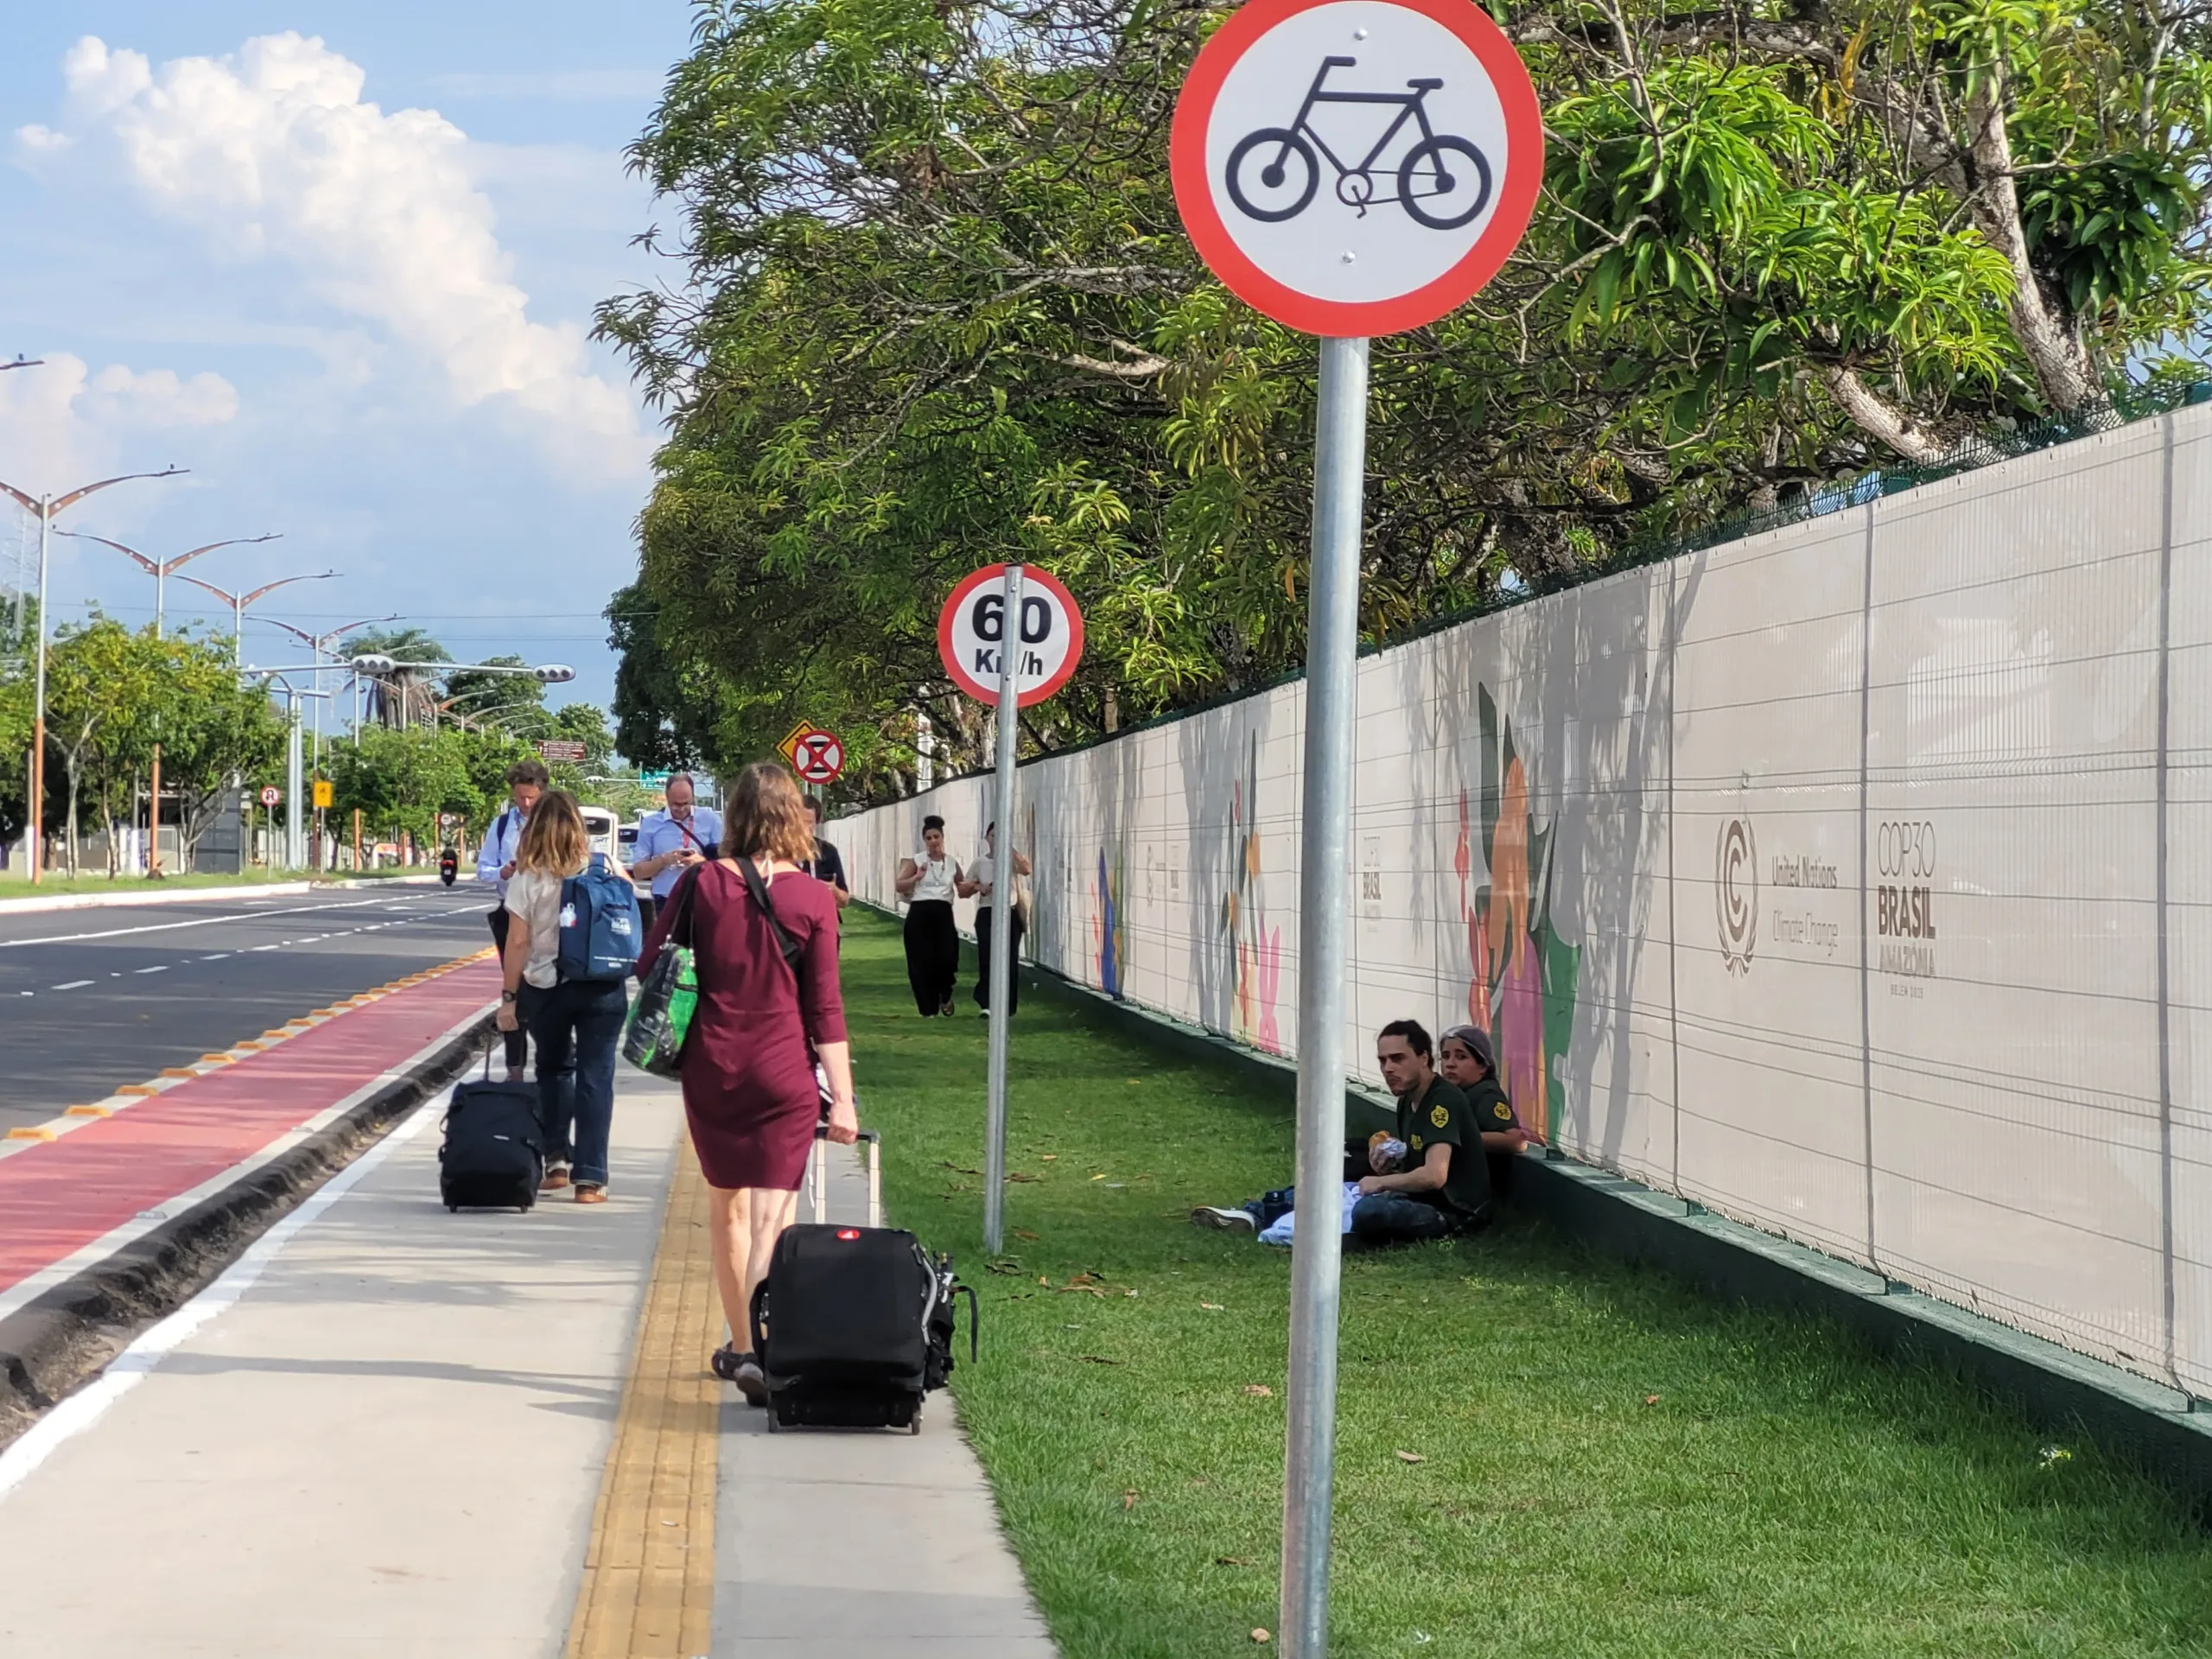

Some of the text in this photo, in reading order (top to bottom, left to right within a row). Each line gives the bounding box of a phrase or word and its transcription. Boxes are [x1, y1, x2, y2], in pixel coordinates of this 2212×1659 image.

[972, 594, 1052, 644] 60
[975, 648, 1043, 676] K/h
[1772, 854, 1838, 889] United Nations
[1878, 821, 1936, 878] COP30
[1878, 885, 1936, 940] BRASIL
